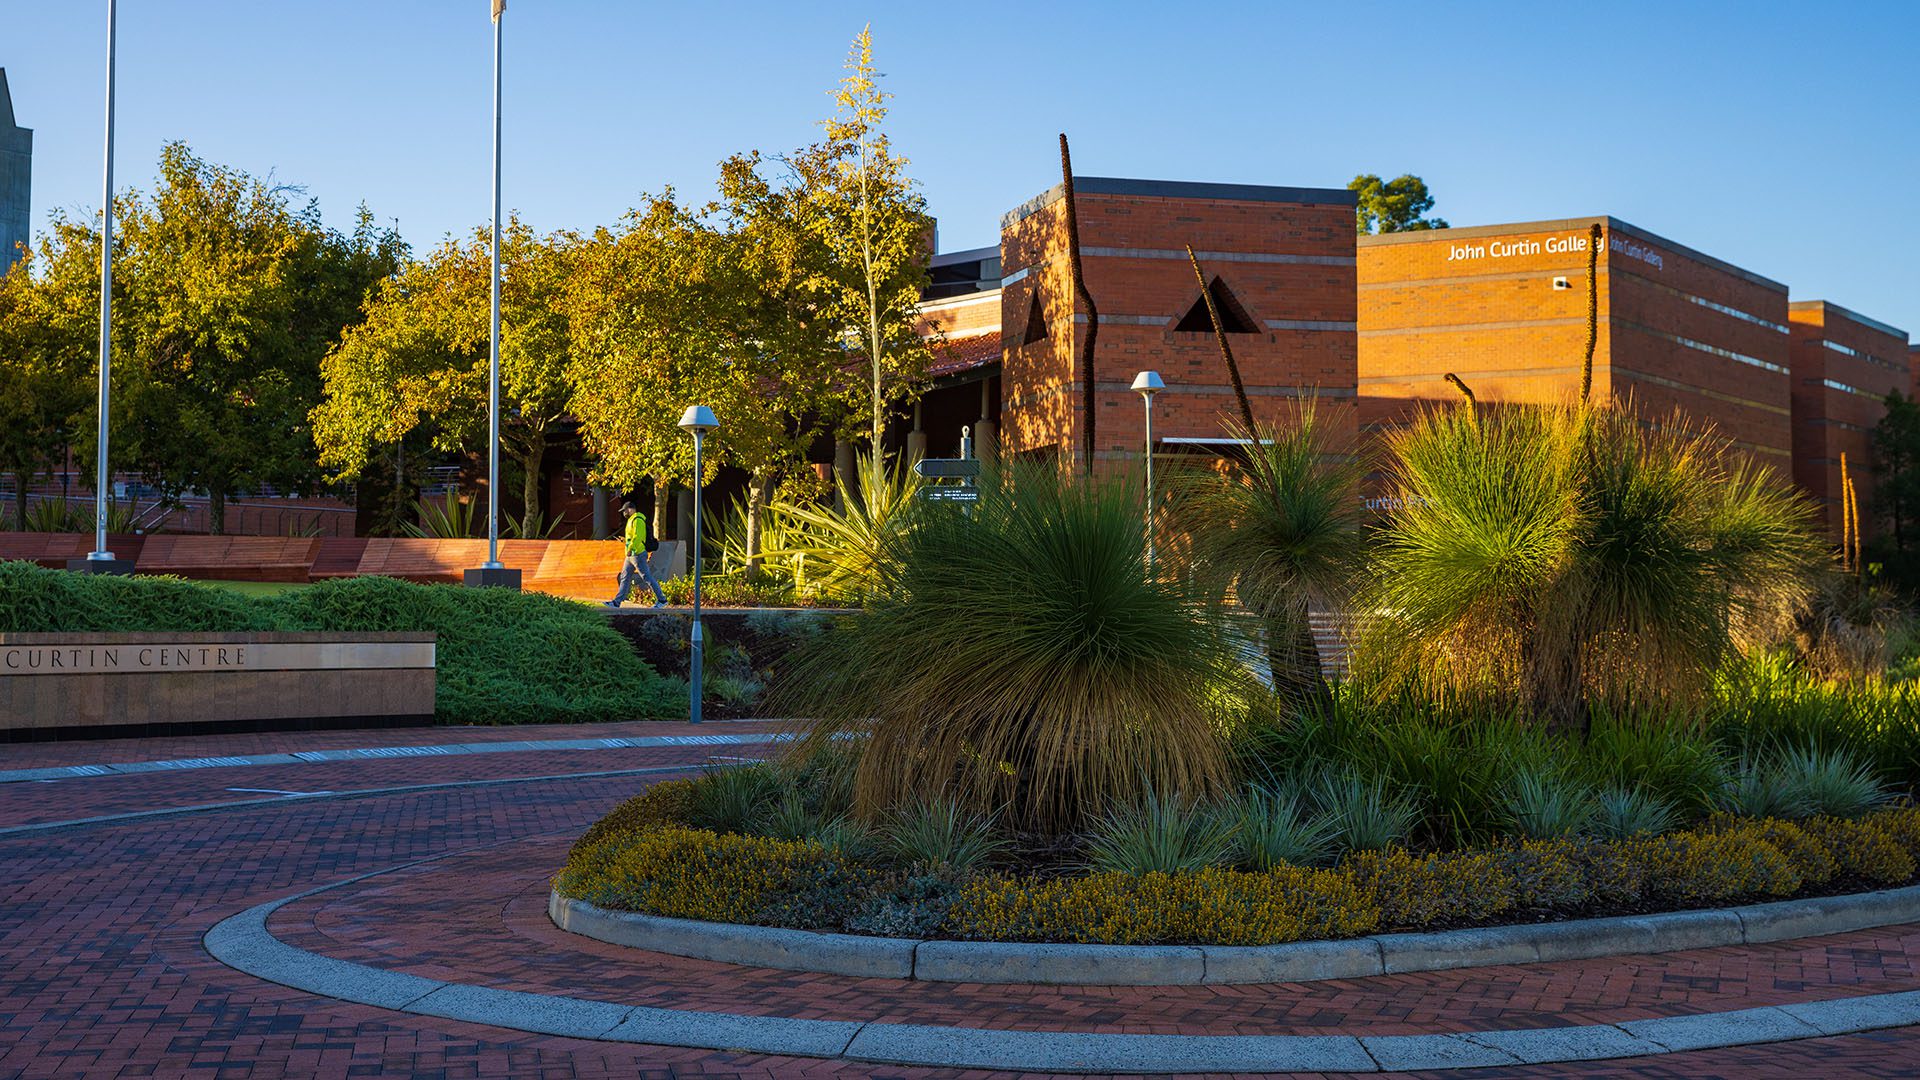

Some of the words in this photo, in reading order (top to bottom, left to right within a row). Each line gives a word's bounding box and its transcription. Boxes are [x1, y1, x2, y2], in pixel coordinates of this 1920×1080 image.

[1448, 245, 1485, 261] John
[1489, 239, 1540, 257] Curtin
[1545, 235, 1604, 254] Galley
[6, 649, 119, 669] CURTIN
[138, 647, 245, 667] CENTRE
[660, 734, 743, 745] PARKING
[355, 745, 449, 757] FOOTPATH
